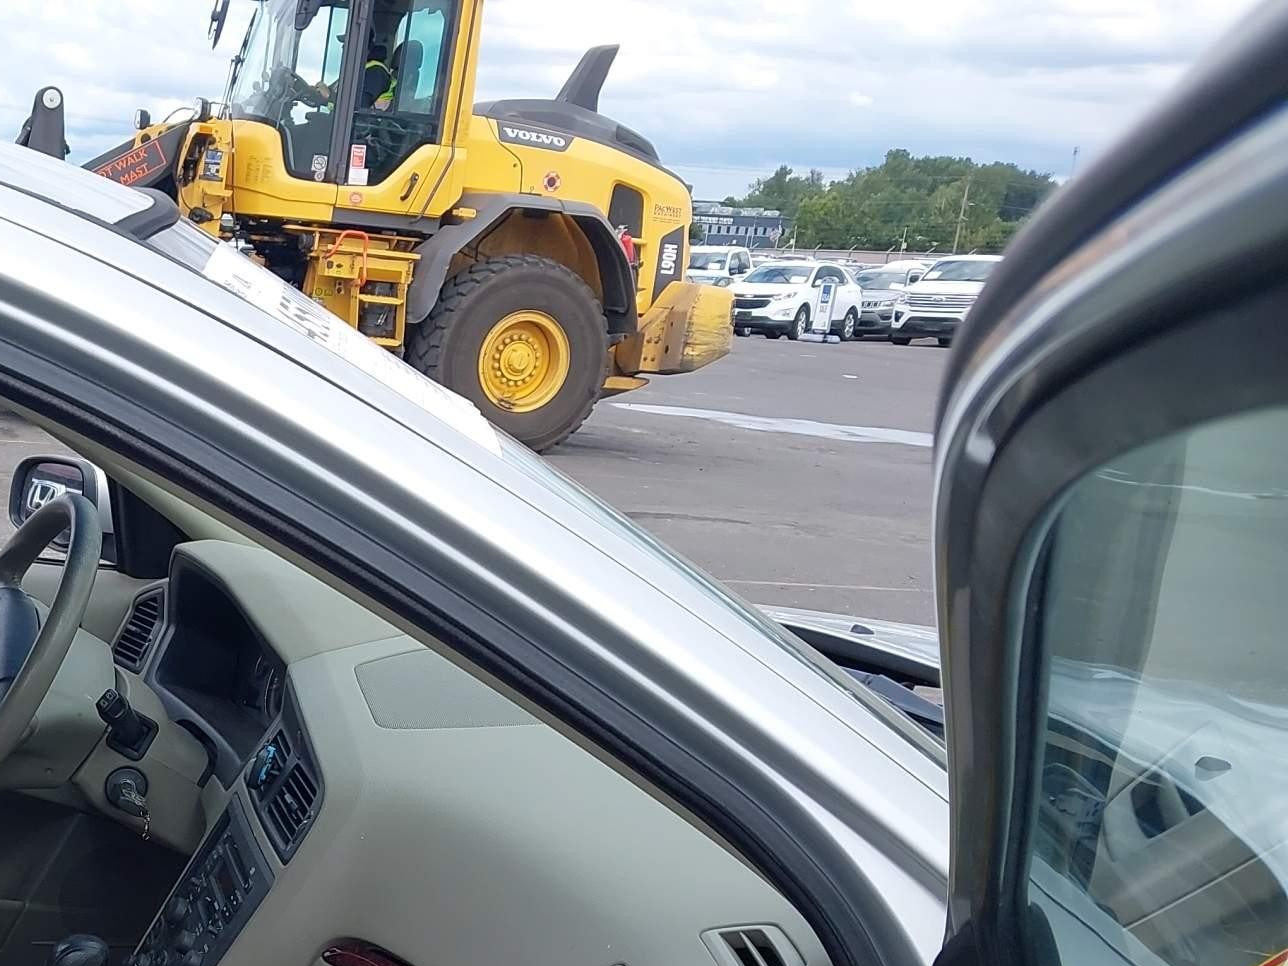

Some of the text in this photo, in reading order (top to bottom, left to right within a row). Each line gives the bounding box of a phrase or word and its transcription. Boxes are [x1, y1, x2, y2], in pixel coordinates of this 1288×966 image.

[503, 127, 566, 147] VOLVO
[114, 147, 149, 171] WALK
[119, 162, 149, 186] MAST
[660, 243, 679, 275] L90H
